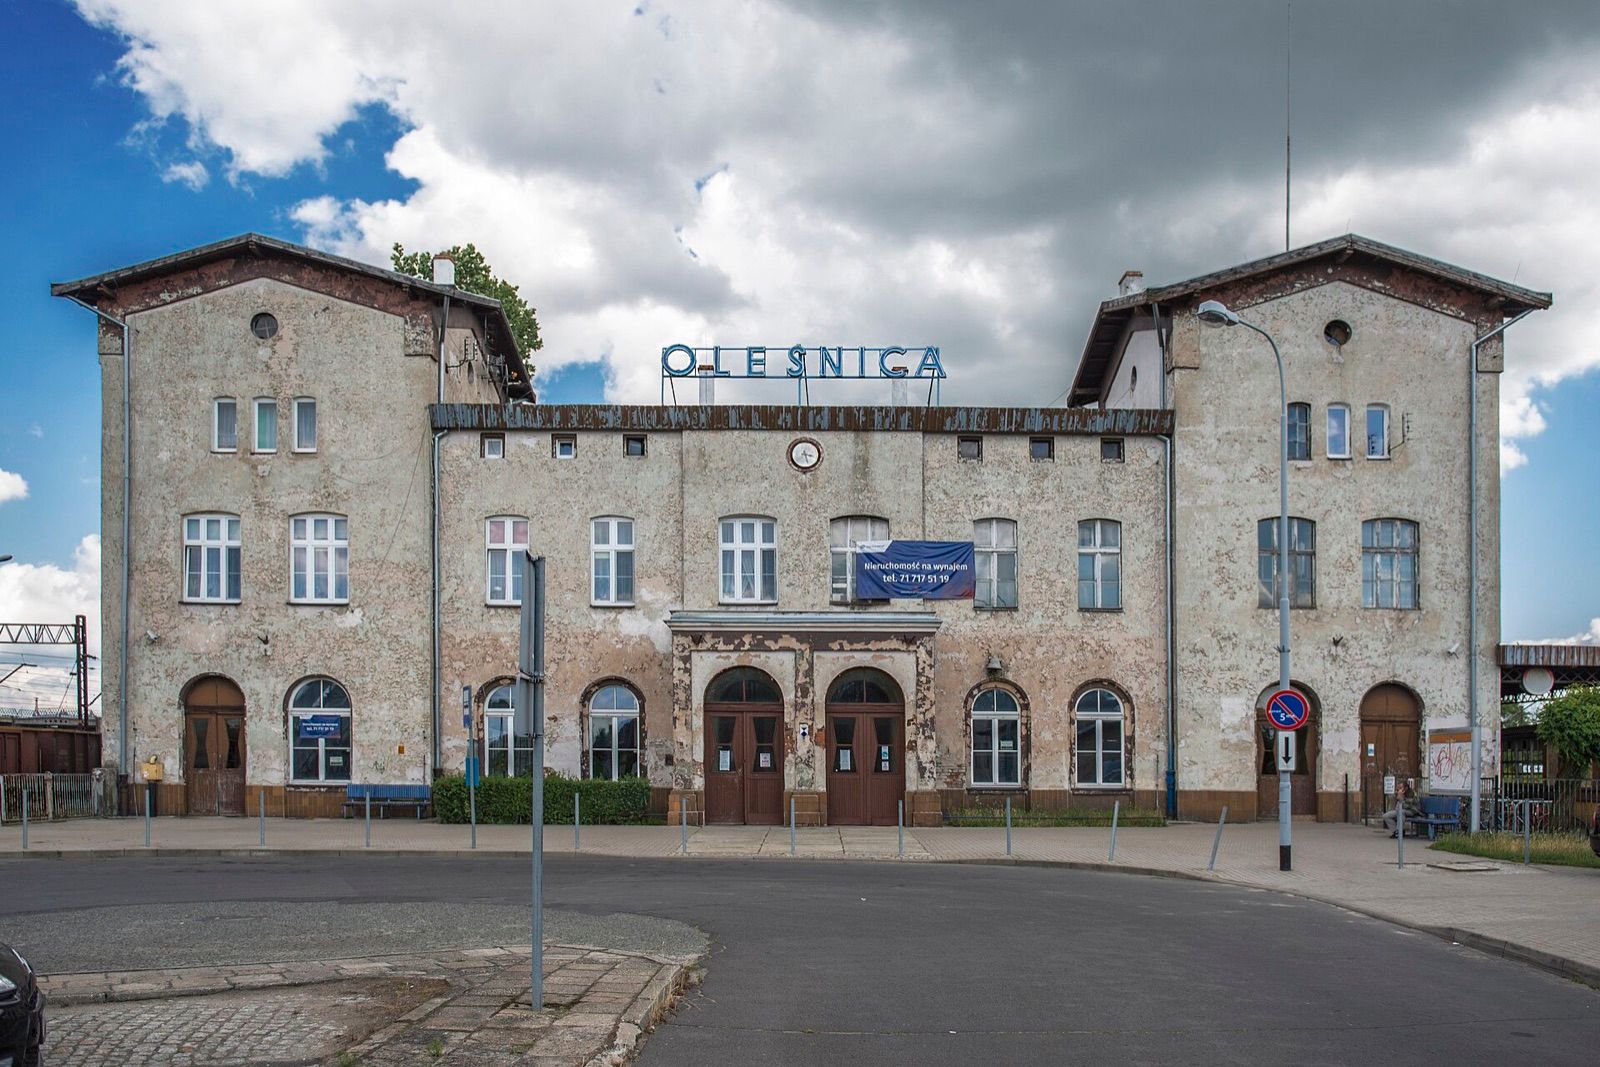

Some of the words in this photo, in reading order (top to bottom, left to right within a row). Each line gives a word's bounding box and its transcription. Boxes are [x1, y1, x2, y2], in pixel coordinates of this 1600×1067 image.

[864, 562, 920, 570] Nieruchomość
[933, 563, 968, 571] wynajem
[883, 573, 898, 583] tel.
[900, 574, 909, 583] 71
[911, 574, 925, 583] 717
[927, 574, 937, 583] 51
[940, 575, 949, 583] 19
[1280, 712, 1286, 721] 5
